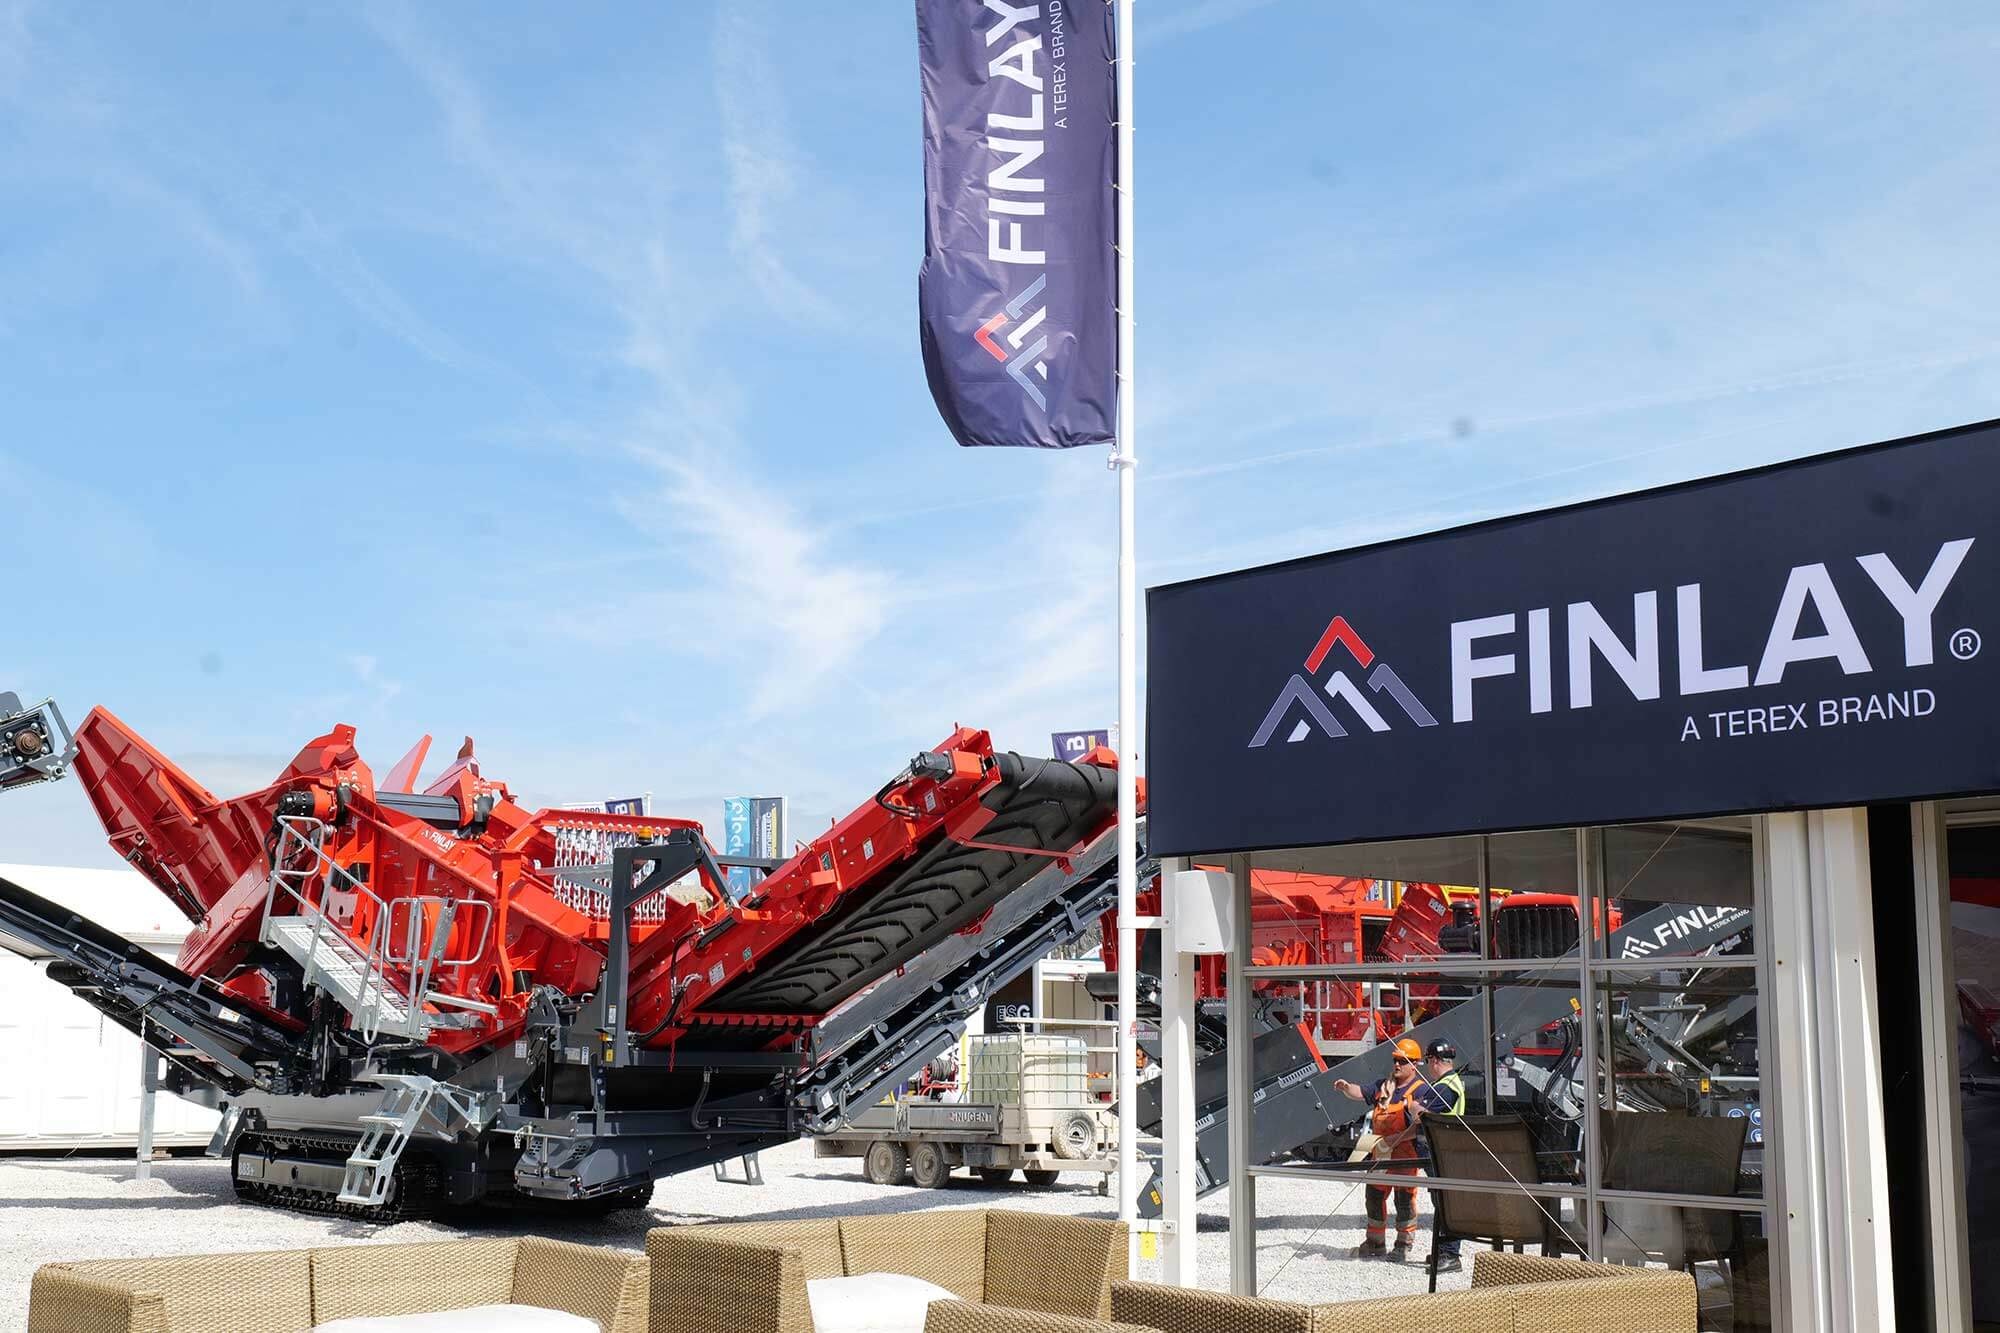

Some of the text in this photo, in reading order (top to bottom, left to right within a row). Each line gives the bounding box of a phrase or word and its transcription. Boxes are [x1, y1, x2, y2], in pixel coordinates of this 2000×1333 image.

[1049, 0, 1067, 128] A TEREX BRAND
[984, 0, 1045, 264] FINLAY
[1450, 537, 1976, 723] FINLAY
[1681, 689, 1936, 742] A TEREX BRAND
[429, 831, 457, 851] FINLAY
[1653, 905, 1738, 947] FINLA
[996, 1004, 1030, 1023] ESG
